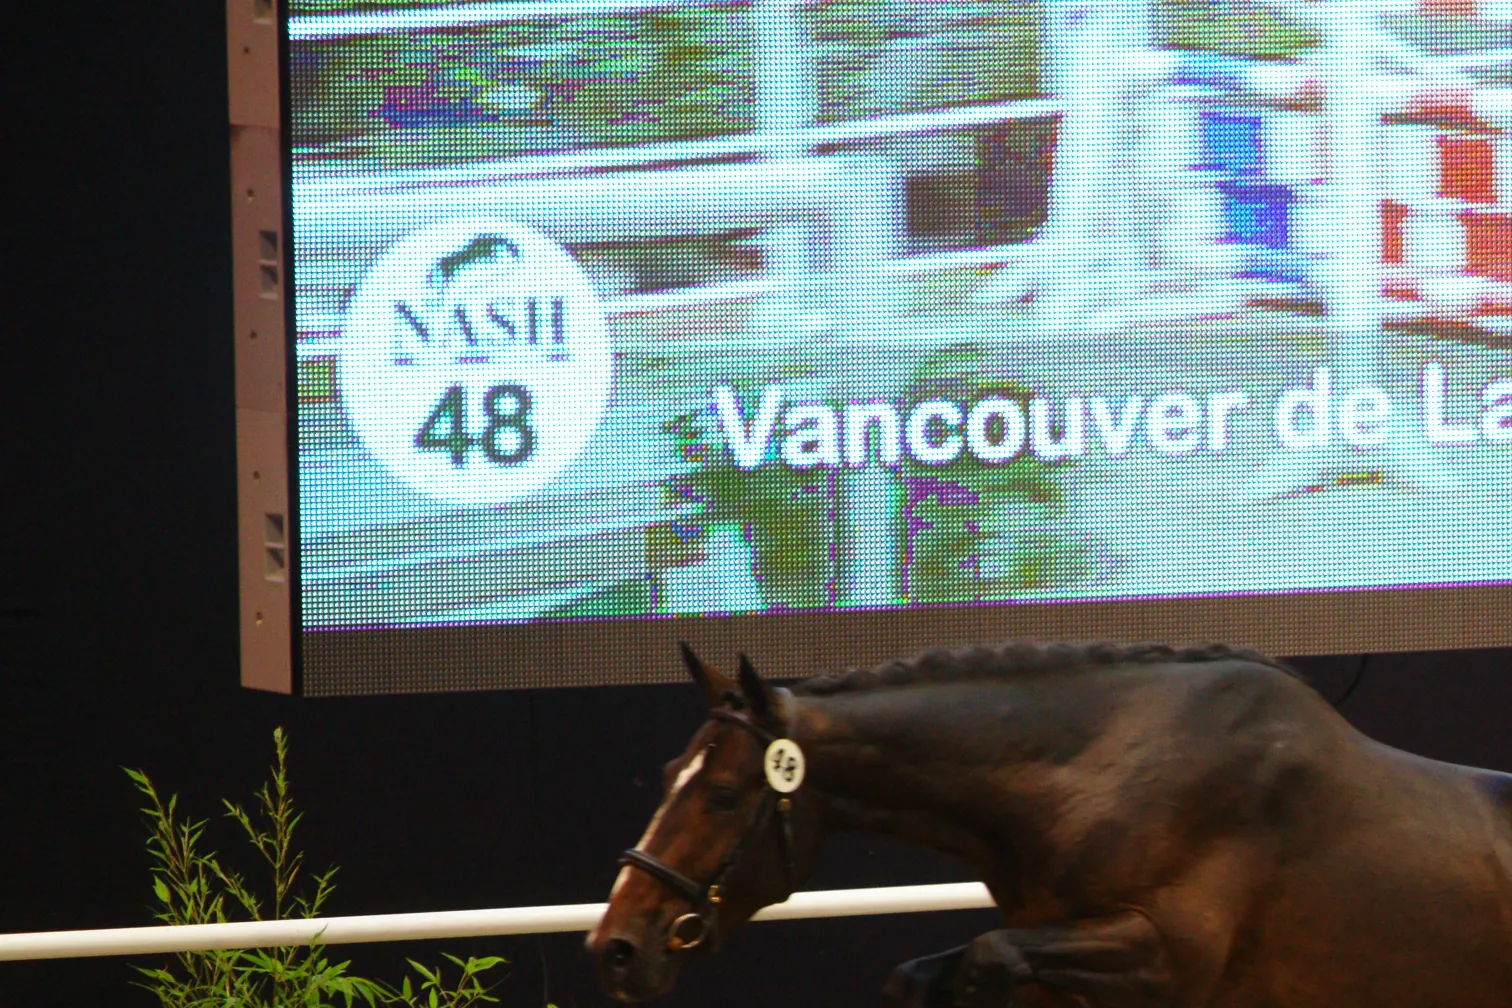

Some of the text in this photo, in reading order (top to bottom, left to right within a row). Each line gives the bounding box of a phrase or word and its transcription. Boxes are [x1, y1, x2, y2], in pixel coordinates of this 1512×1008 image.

[413, 381, 537, 468] 48
[712, 382, 1246, 470] Vancouver
[1274, 365, 1390, 448] de
